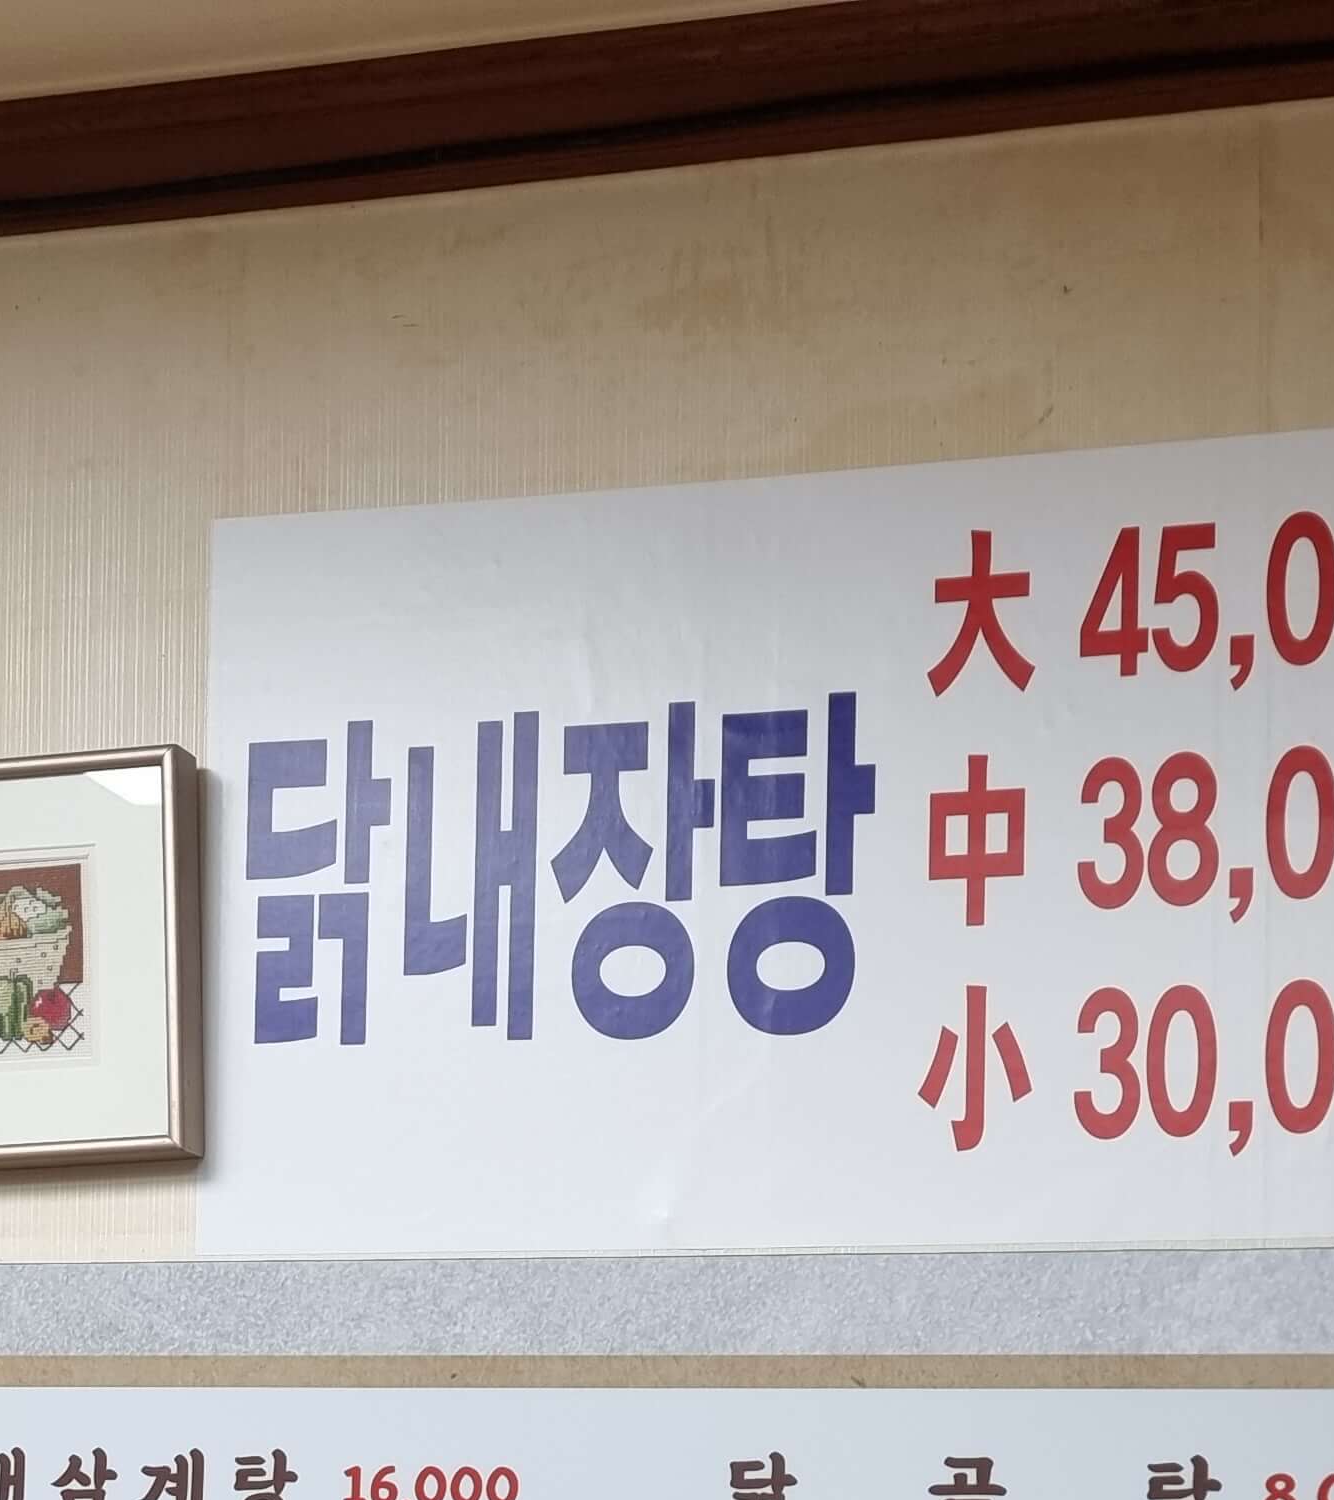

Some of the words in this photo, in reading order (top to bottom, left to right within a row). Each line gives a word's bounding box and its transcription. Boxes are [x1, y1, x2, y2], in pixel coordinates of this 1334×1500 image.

[930, 531, 1035, 695] 大
[245, 691, 876, 1046] 닭내장탕
[928, 755, 1026, 926] 中
[919, 985, 1031, 1151] 小
